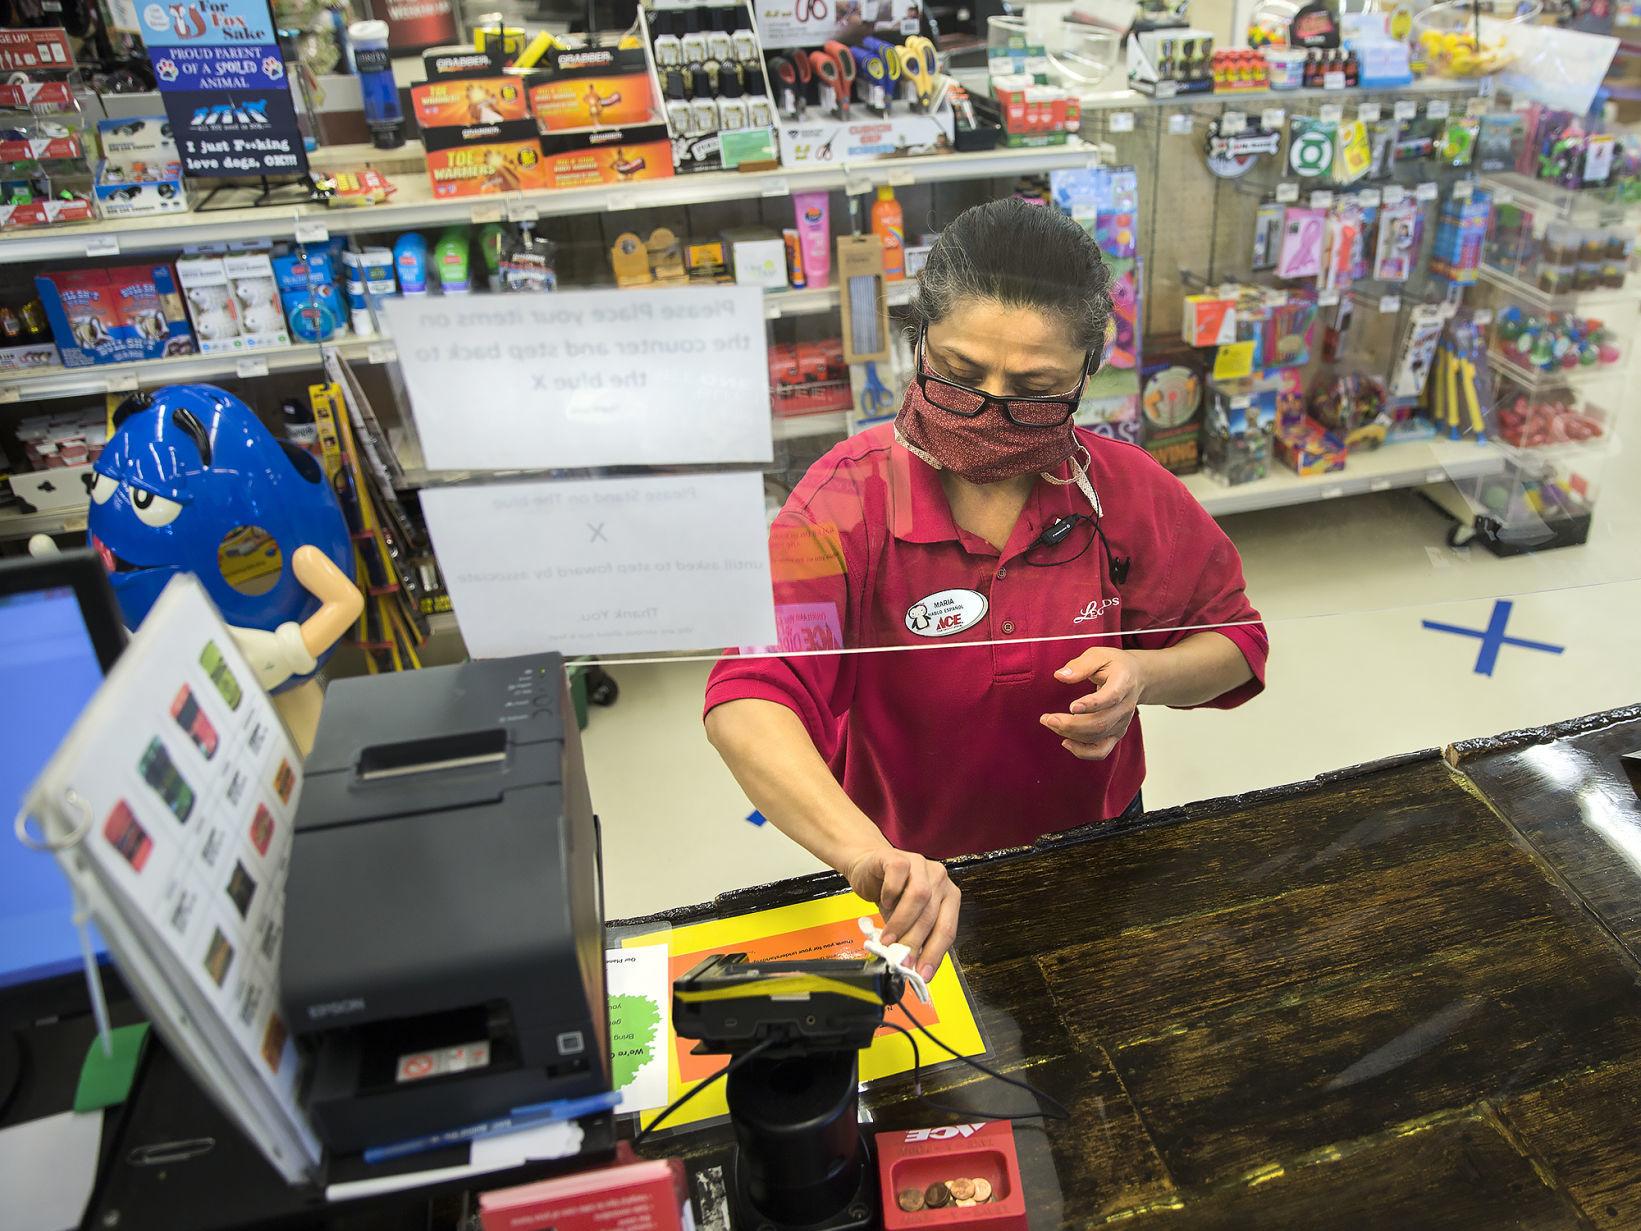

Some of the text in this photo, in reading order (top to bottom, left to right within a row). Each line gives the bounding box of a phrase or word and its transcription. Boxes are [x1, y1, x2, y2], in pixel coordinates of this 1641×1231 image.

[200, 0, 228, 12] For
[211, 14, 246, 27] Fox
[222, 27, 266, 40] Sake
[168, 46, 262, 60] PROUD PARENT
[182, 59, 258, 76] OF A SPOILED
[199, 76, 250, 89] ANIMAL
[185, 140, 196, 153] I
[200, 140, 231, 154] just
[185, 157, 219, 170] love
[223, 156, 260, 170] dogs,
[446, 150, 475, 167] TOE
[433, 163, 497, 181] WARMERS
[96, 341, 127, 356] BULL
[933, 598, 955, 609] MARIA
[943, 603, 965, 613] ESPAÑOL
[936, 613, 962, 631] ACE
[306, 998, 367, 1020] EPSON
[613, 1033, 635, 1041] Bring
[618, 1048, 644, 1056] We're
[904, 1122, 987, 1143] ACE
